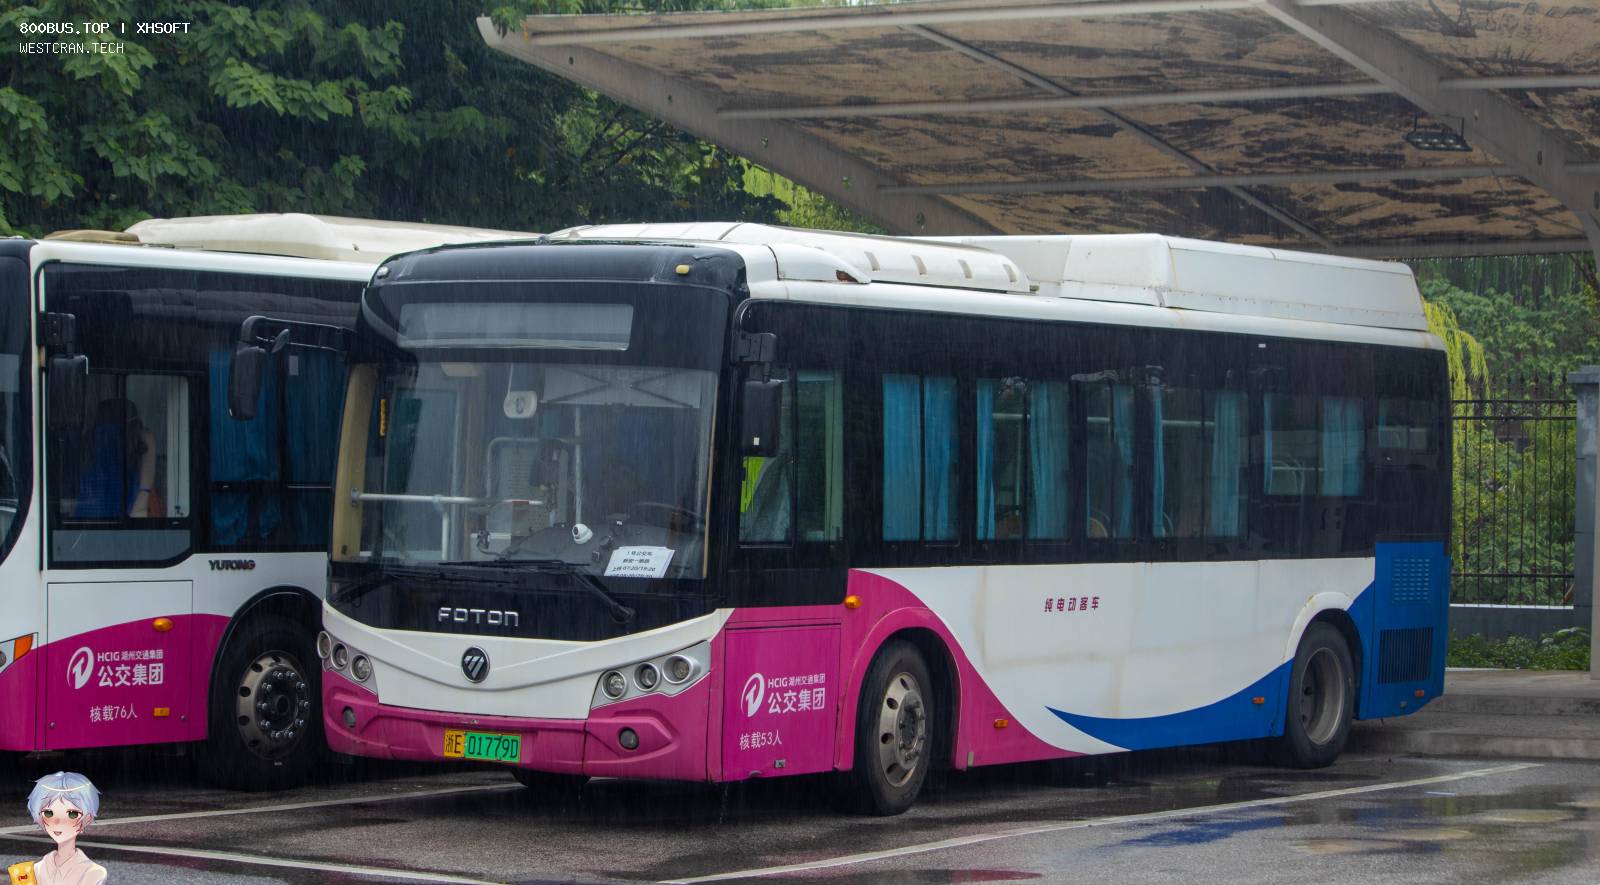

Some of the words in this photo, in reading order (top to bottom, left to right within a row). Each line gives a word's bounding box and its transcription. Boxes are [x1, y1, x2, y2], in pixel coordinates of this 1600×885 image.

[208, 559, 256, 570] YUTONG
[1044, 596, 1100, 612] 纯电动客车
[438, 606, 519, 627] FOTON
[97, 652, 120, 662] HCIG
[121, 649, 163, 660] 湖州交通集团
[98, 663, 164, 687] 公交集团
[768, 678, 788, 688] HCIG
[788, 673, 826, 686] 湖州交通集团
[768, 687, 826, 714] 公交集团
[90, 703, 138, 723] 核载76人
[740, 729, 782, 751] 核载53人
